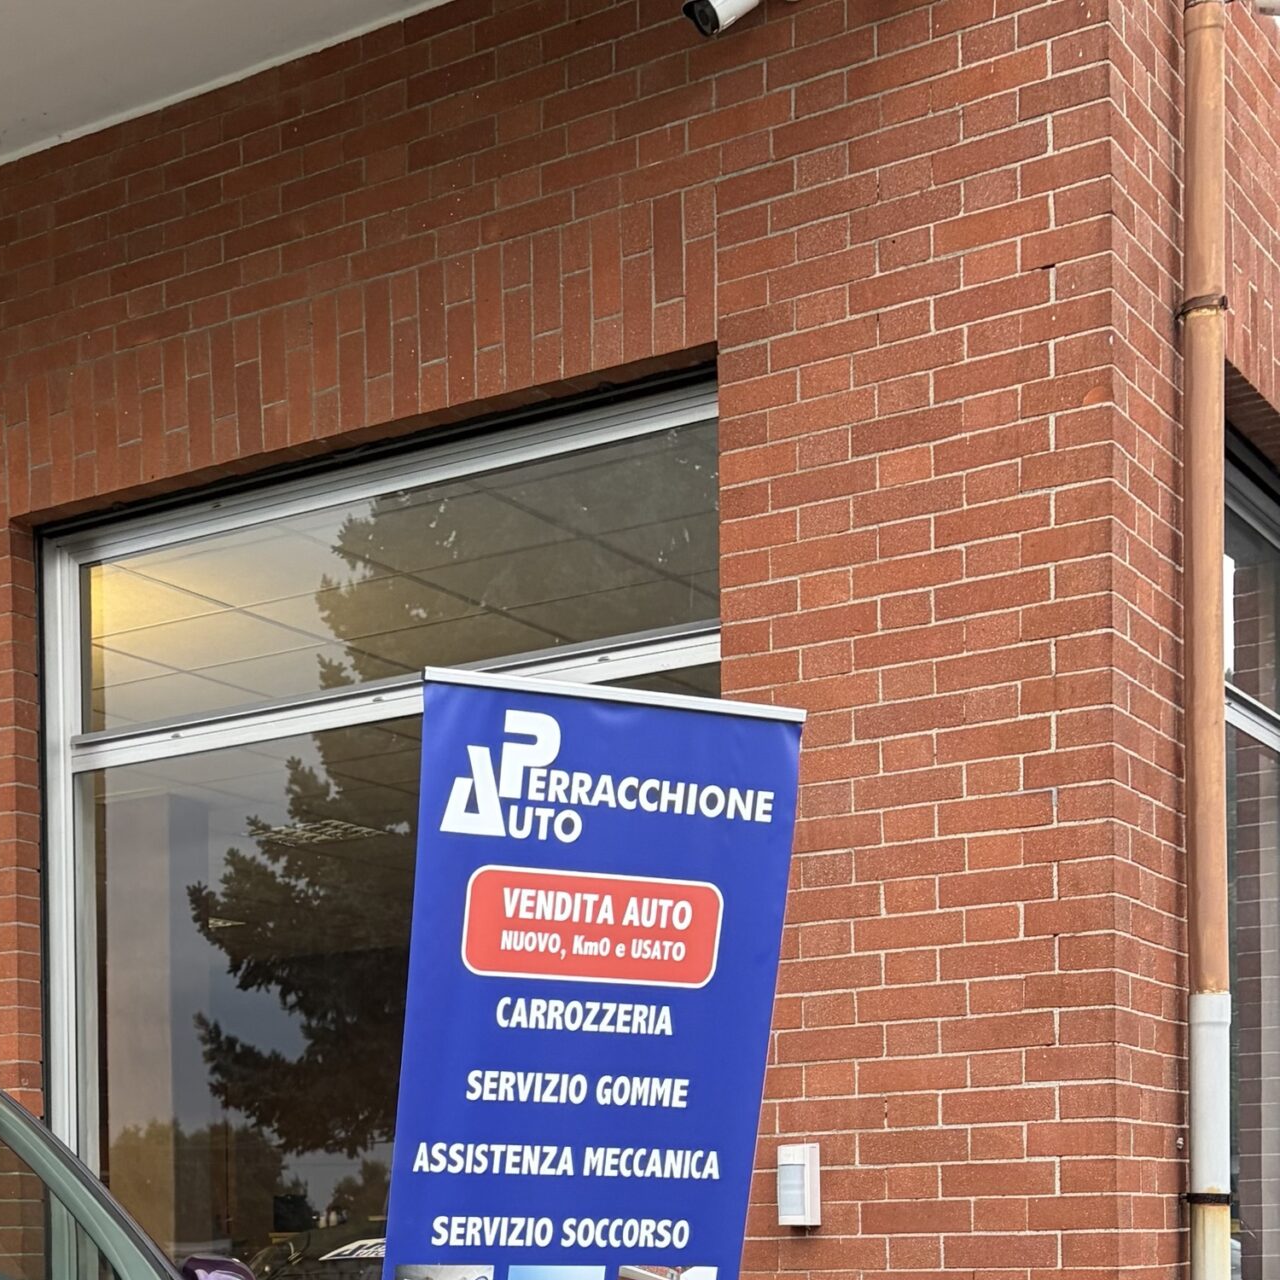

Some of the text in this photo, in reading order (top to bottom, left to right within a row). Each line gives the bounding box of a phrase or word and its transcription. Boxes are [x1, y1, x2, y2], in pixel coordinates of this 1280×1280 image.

[499, 709, 774, 823] PERRACCHIONE
[440, 745, 582, 843] AUTO
[504, 887, 693, 931] VENDITA AUTO
[500, 930, 686, 962] NUOVO, Km0 e USATO
[496, 997, 673, 1036] CARROZZERIA
[466, 1069, 690, 1108] SERVIZIO GOMME
[413, 1142, 720, 1179] ASSISTENZA MECCANICA
[431, 1216, 690, 1250] SERVIZIO SOCCORSO
